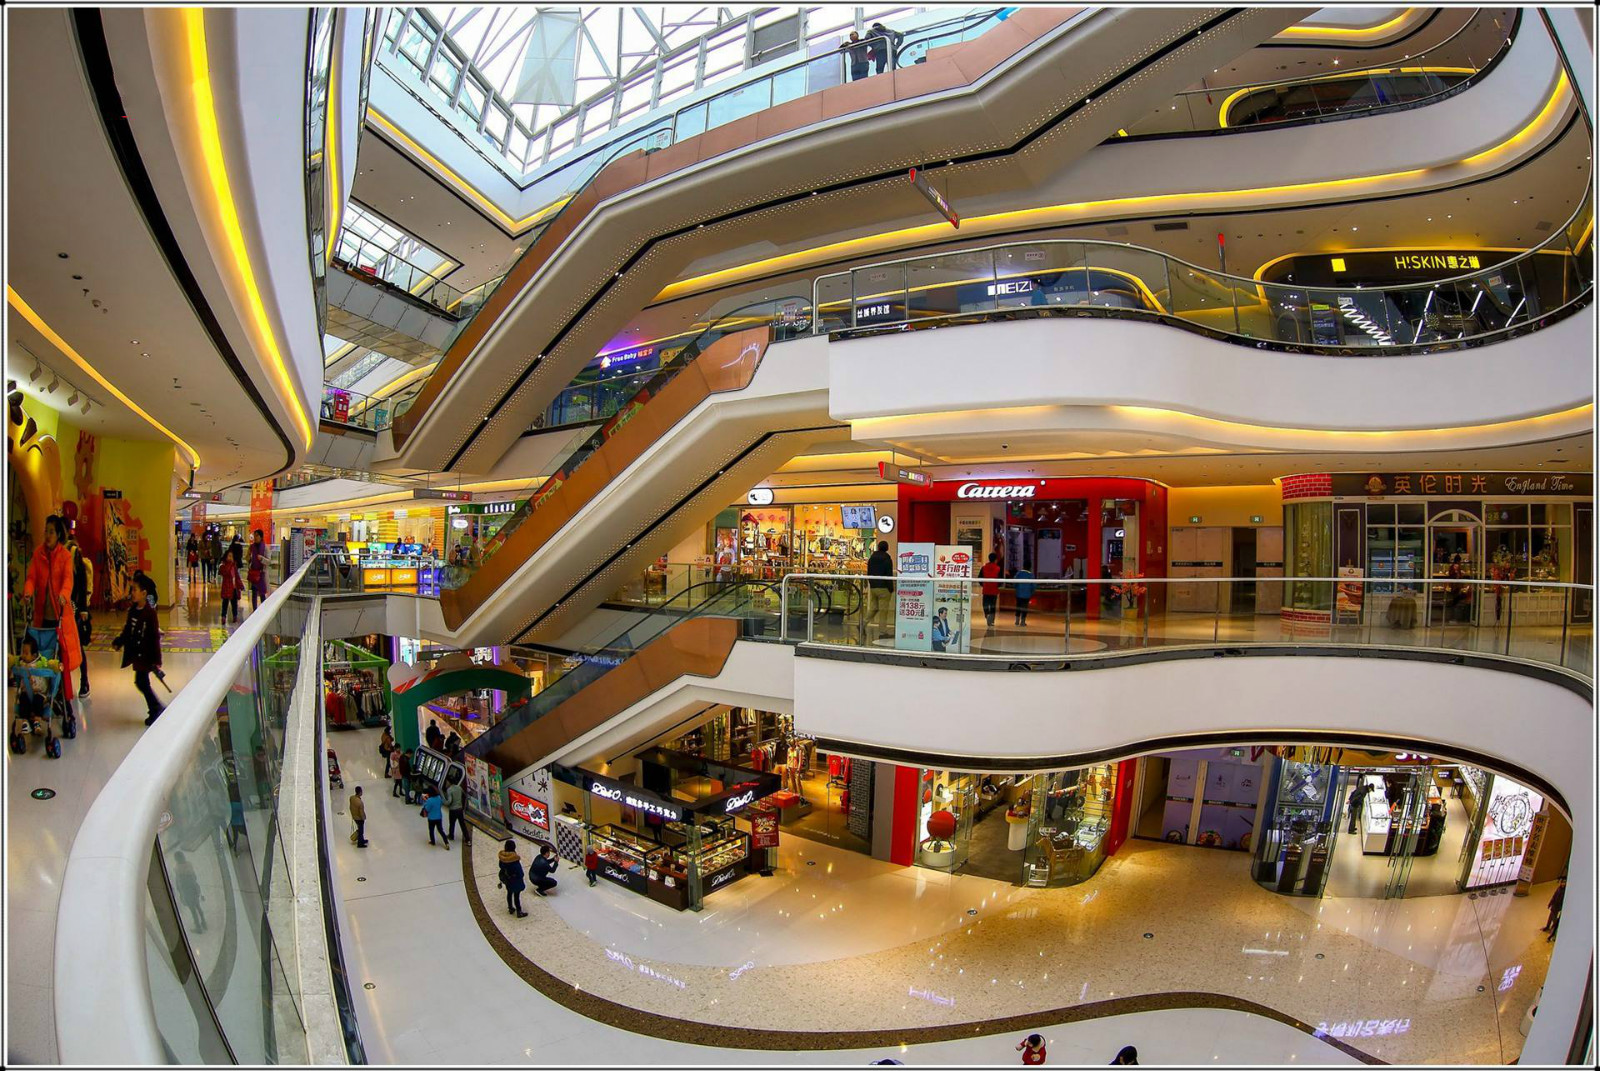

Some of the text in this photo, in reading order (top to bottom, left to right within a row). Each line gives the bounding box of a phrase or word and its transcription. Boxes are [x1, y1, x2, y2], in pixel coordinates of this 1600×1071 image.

[1395, 255, 1447, 270] H!SKIN
[624, 352, 637, 361] Baby
[957, 482, 1035, 499] Carrera
[1394, 474, 1574, 494] 英伦时光 England Time
